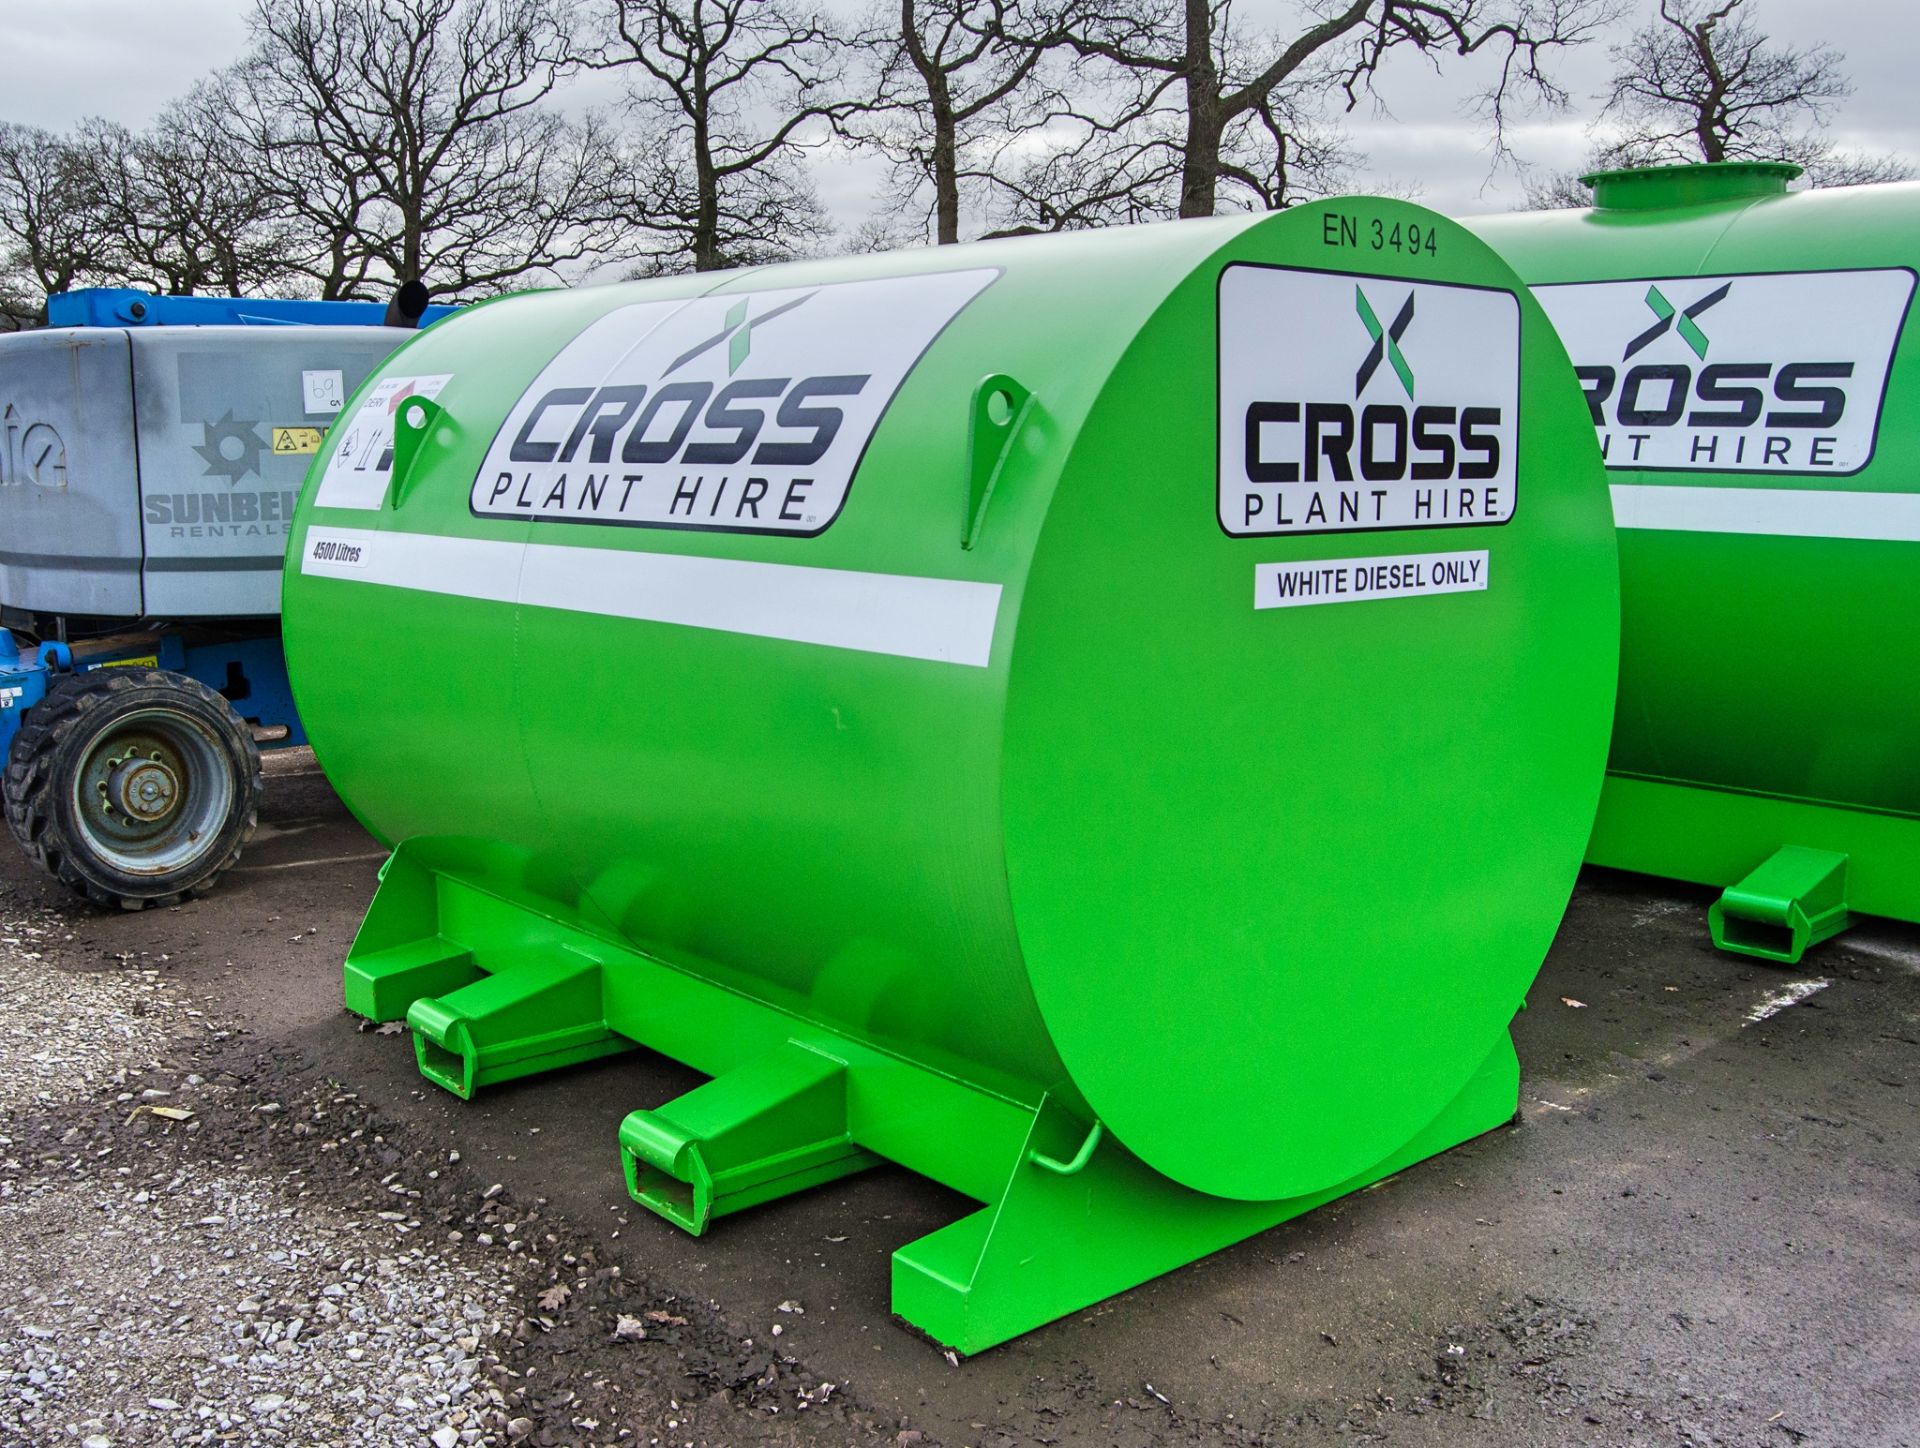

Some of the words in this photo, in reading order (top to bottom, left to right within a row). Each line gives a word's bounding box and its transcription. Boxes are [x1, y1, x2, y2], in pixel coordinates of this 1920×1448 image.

[1323, 212, 1357, 248] EN
[1371, 218, 1437, 258] 3494
[1573, 362, 1855, 429] ROSS
[509, 374, 873, 465] CROSS
[1245, 400, 1502, 484] CROSS
[1690, 436, 1838, 467] HIRE
[145, 491, 300, 525] SUNBEL
[488, 471, 643, 513] PLANT
[669, 475, 814, 521] HIRE
[1245, 489, 1388, 526] PLANT
[1415, 487, 1499, 519] HIRE
[313, 541, 336, 561] 4500
[335, 543, 362, 562] Litres
[1277, 568, 1348, 598] WHITE
[1355, 563, 1426, 592] DIESEL
[1432, 559, 1481, 586] ONLY
